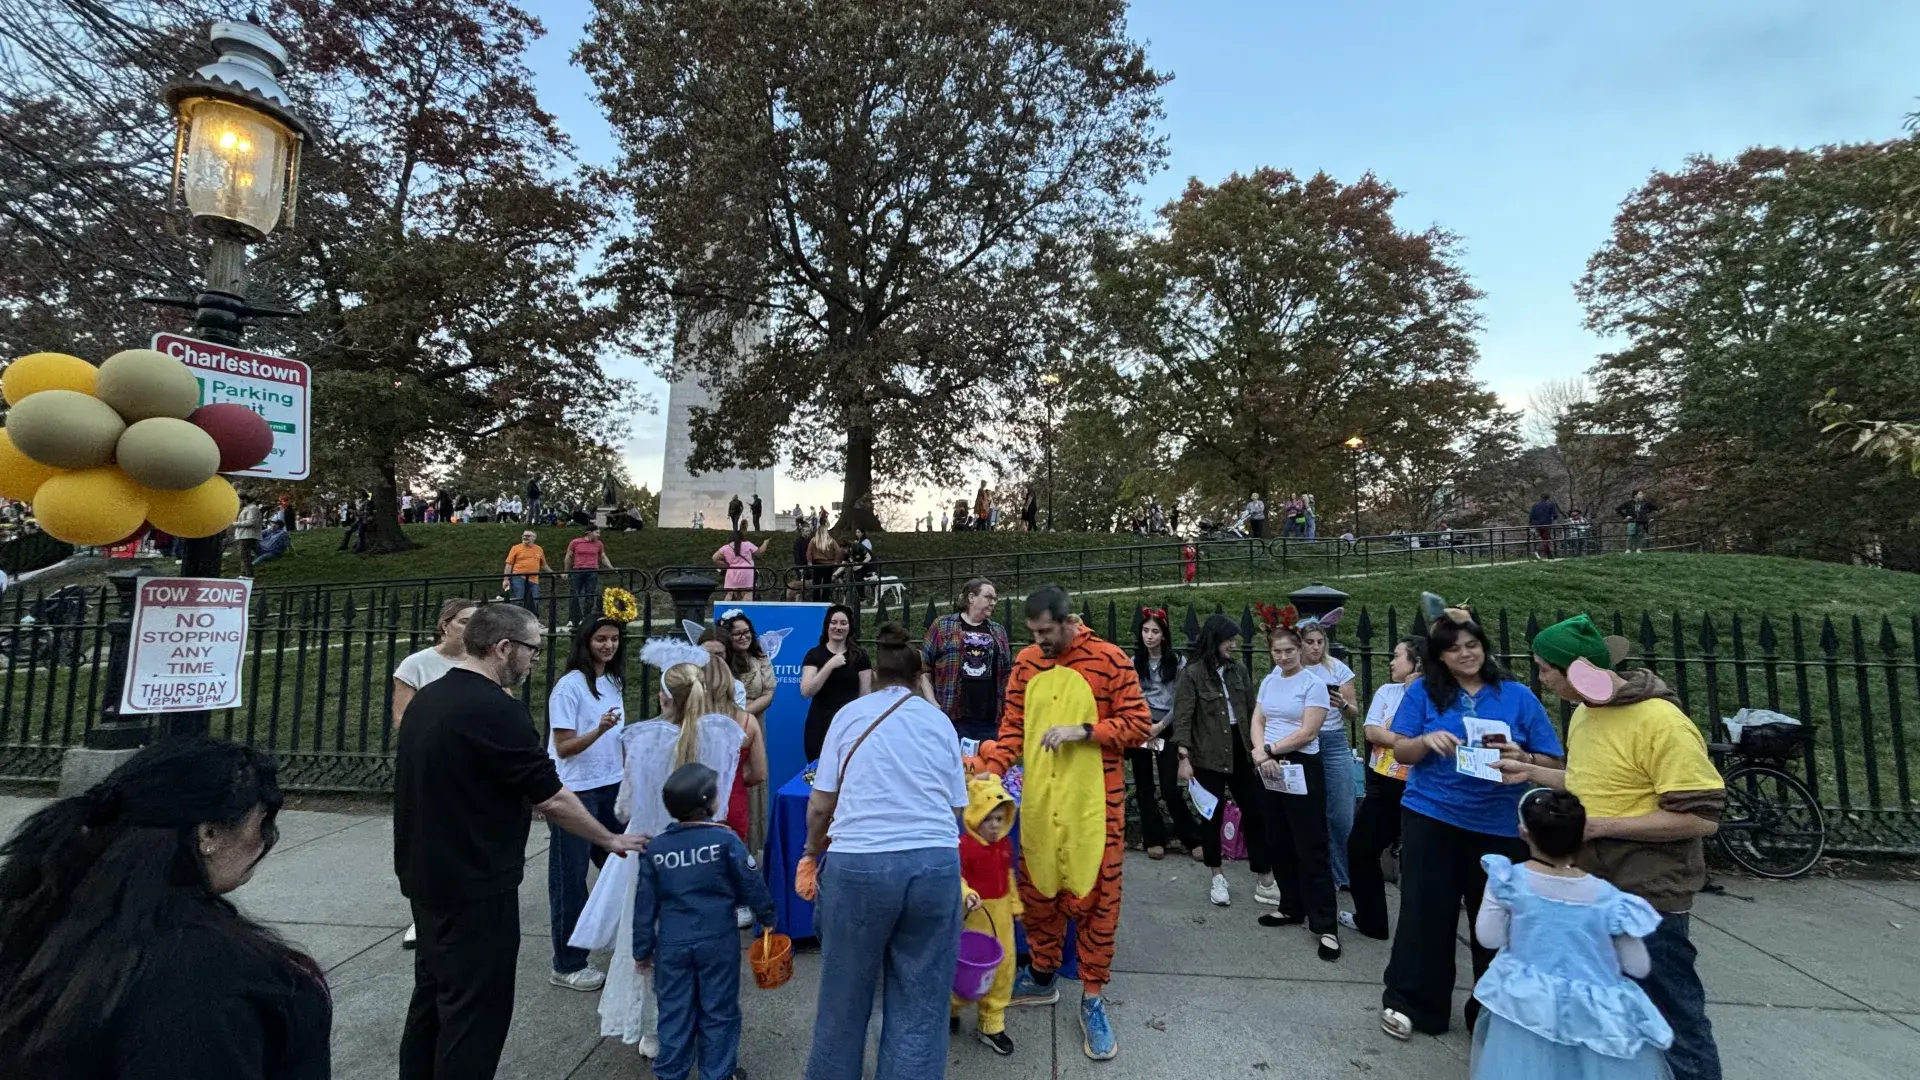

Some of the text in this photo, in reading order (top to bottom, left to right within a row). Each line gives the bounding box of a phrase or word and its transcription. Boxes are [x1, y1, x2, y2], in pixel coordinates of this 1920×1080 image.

[166, 341, 301, 383] Charlestown
[212, 380, 294, 408] Parking
[145, 587, 243, 603] TOW ZONE
[176, 613, 215, 628] NO
[142, 631, 240, 643] STOPPING
[170, 646, 213, 658] ANY
[167, 662, 214, 674] TIME
[774, 664, 801, 675] TITU
[141, 681, 227, 698] THURSDAY
[147, 697, 181, 706] 12PM
[196, 694, 221, 704] 8PM
[653, 844, 721, 869] POLICE
